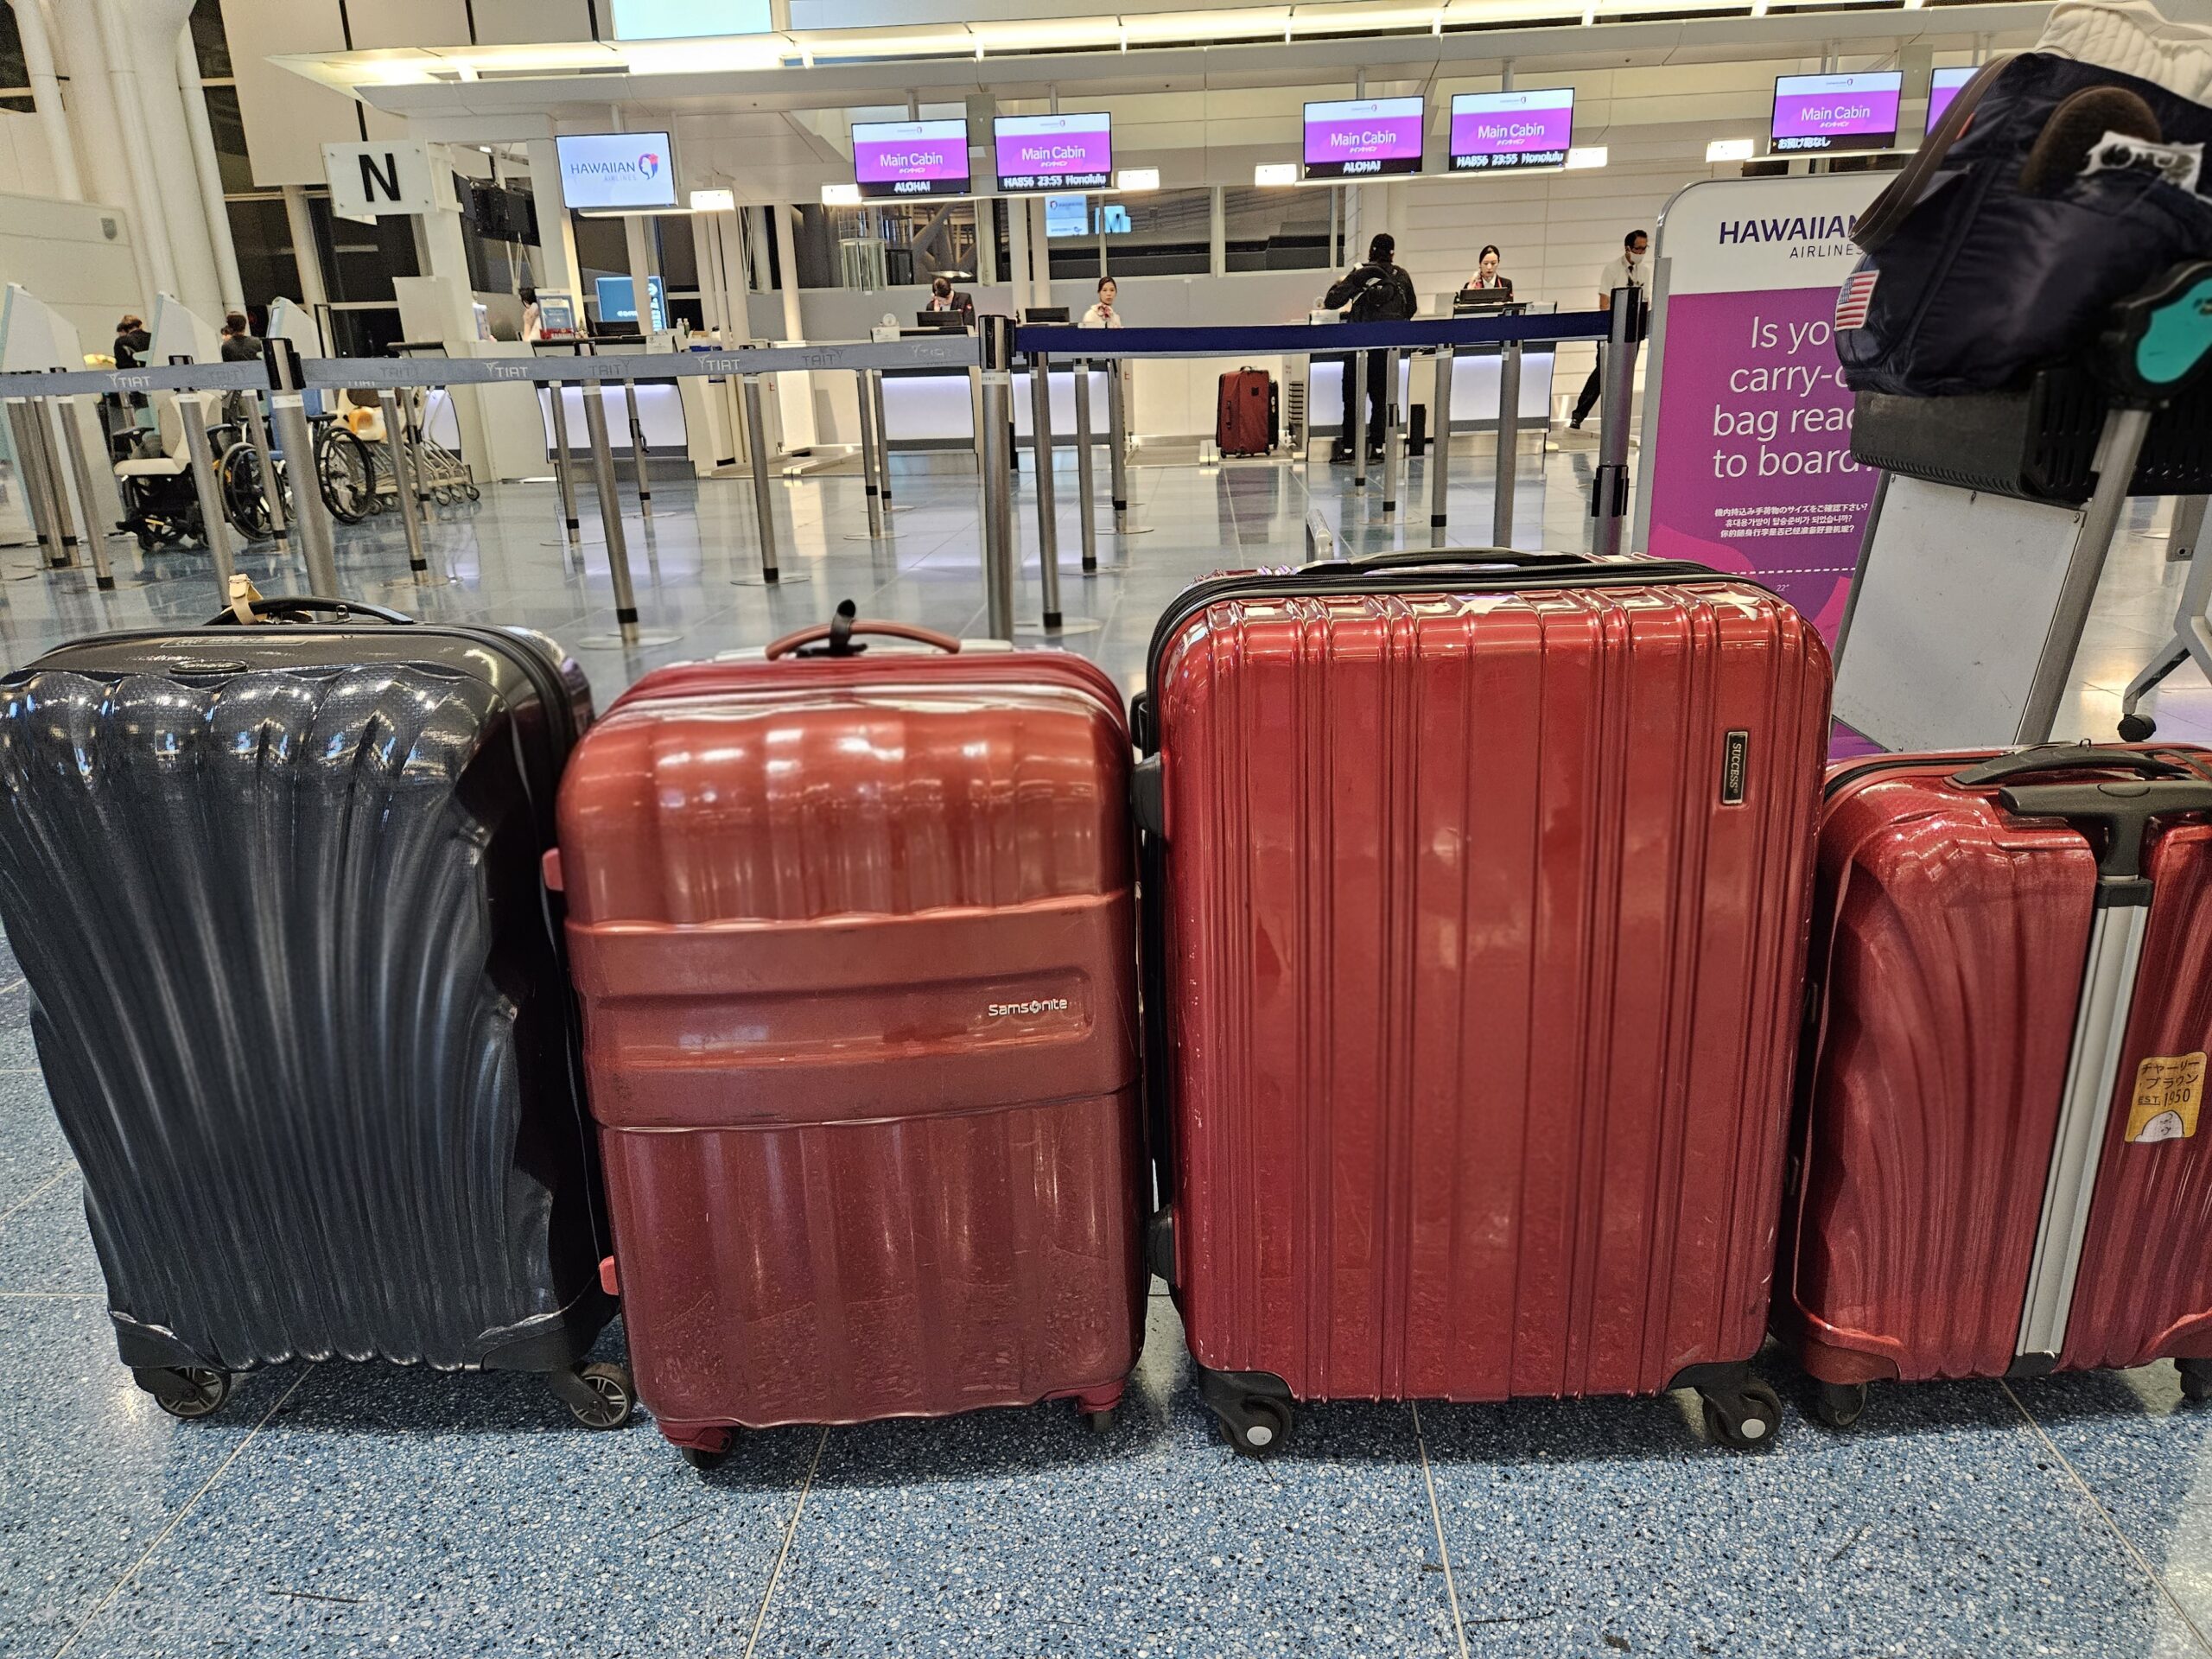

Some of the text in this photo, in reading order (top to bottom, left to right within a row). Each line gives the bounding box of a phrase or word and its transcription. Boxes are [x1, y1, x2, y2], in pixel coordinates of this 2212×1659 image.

[1802, 105, 1870, 121] Main Cabin
[1331, 130, 1396, 147] Main Cabin
[1478, 123, 1545, 139] Main Cabin
[880, 152, 944, 167] Main Cabin
[1021, 145, 1085, 161] Main Cabin
[1457, 151, 1564, 168] HA856 23:55 Honolulu
[570, 161, 636, 174] HAWAIIAN
[1343, 160, 1381, 174] ALOHA!
[359, 153, 401, 202] N
[1065, 173, 1106, 185] Honolulu
[894, 181, 931, 193] ALOHA!
[1751, 316, 1830, 355] Is yo
[495, 365, 529, 378] TIAT
[706, 359, 741, 371] TIAT
[120, 376, 151, 388] TIAT
[1713, 404, 1855, 442] bag rea
[1713, 449, 1747, 478] to
[1730, 743, 1742, 788] SUCCESS
[988, 998, 1068, 1017] Samsonite
[2142, 1059, 2200, 1075] チャーリー
[2145, 1074, 2199, 1090] ブラウン
[2164, 1088, 2190, 1107] 1950
